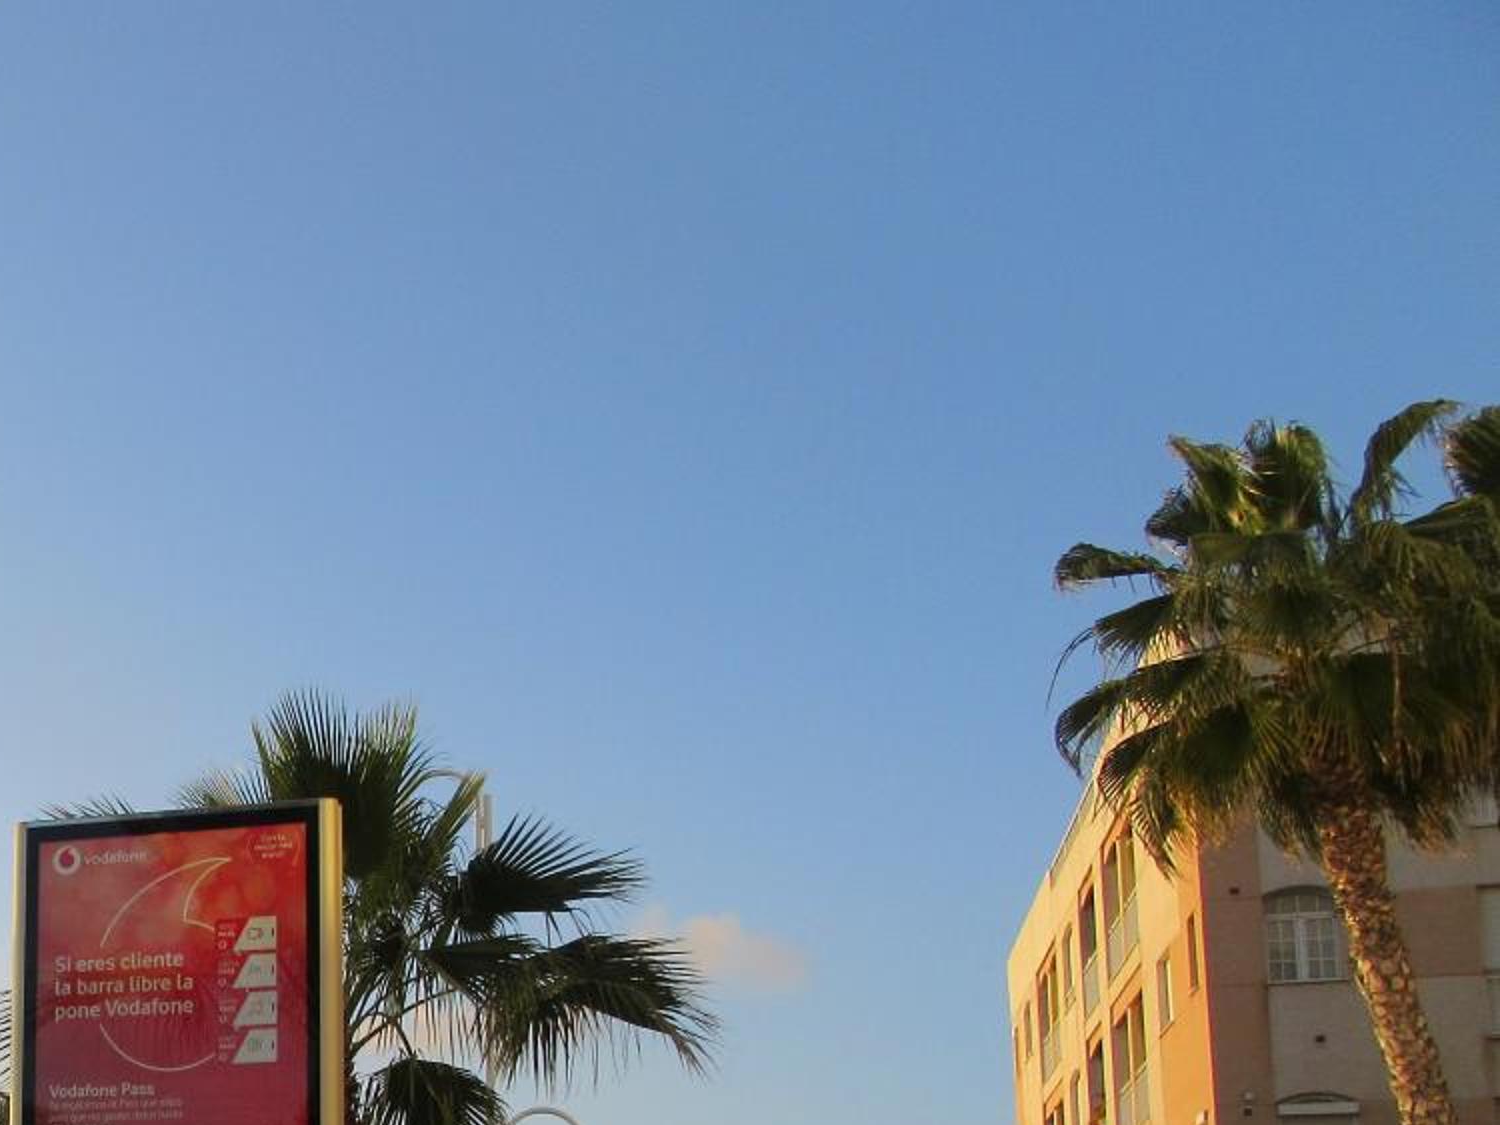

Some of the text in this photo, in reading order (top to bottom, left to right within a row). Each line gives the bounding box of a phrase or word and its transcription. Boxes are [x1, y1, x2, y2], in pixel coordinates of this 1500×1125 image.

[84, 848, 148, 866] vodafone
[54, 952, 184, 973] Si eres cliente
[55, 972, 194, 998] la barra libre la
[54, 1004, 101, 1023] pone
[104, 998, 194, 1019] Vodafone
[49, 1083, 117, 1100] Vodafone
